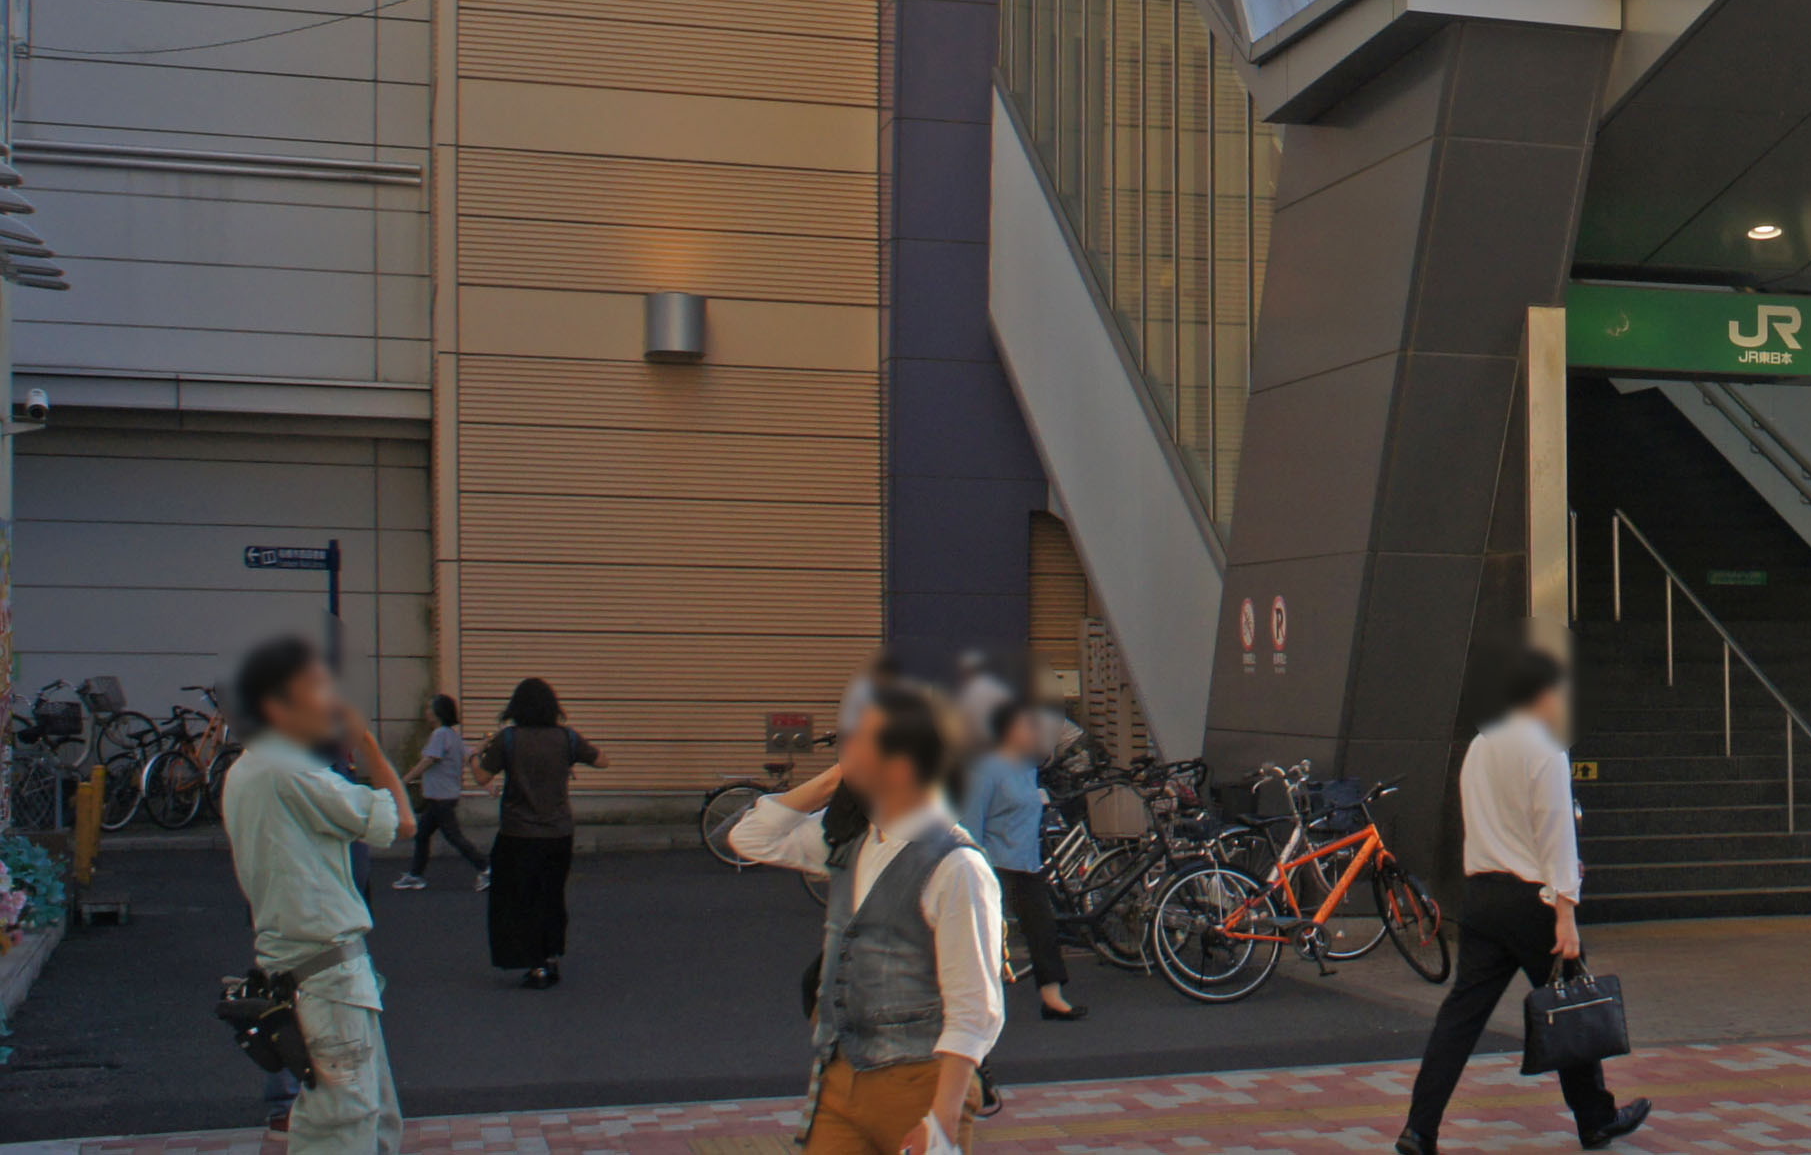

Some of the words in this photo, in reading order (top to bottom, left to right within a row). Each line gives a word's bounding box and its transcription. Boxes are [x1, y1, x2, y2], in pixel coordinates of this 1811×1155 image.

[1729, 305, 1802, 350] JR
[1738, 351, 1793, 365] JR東日本
